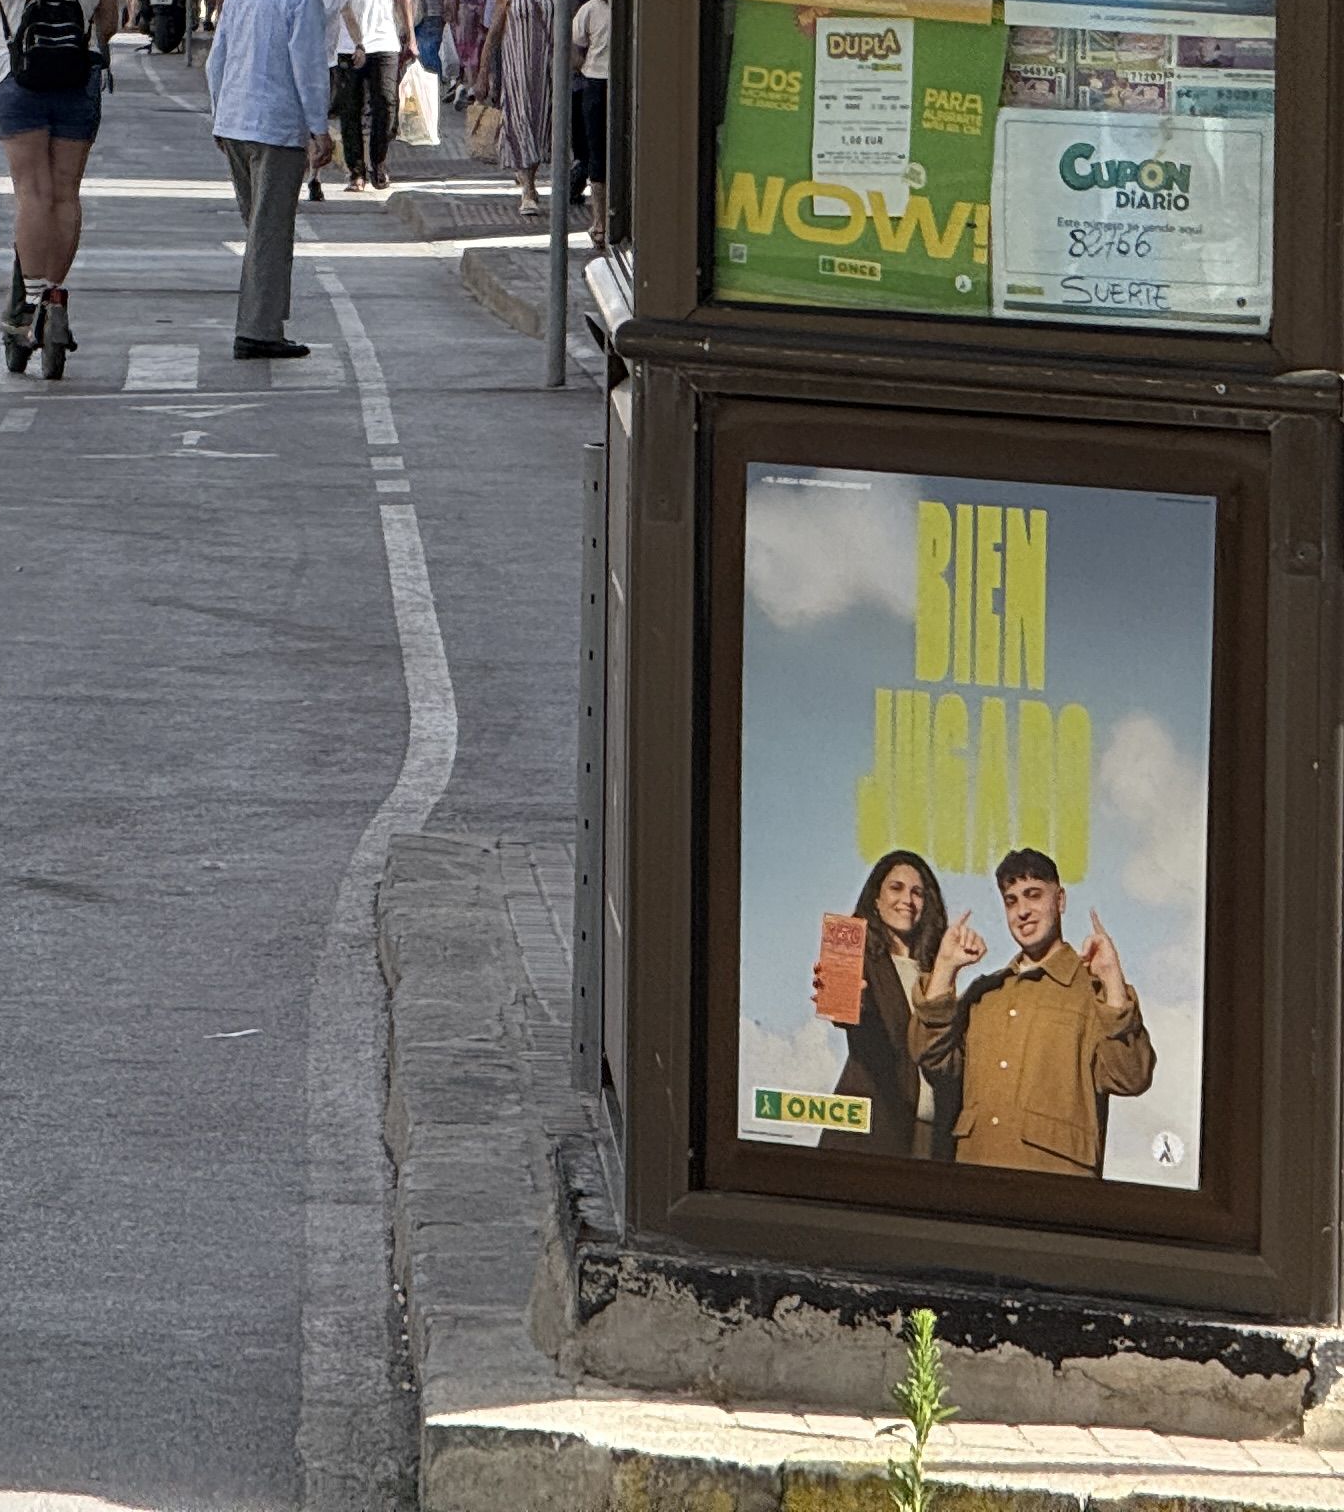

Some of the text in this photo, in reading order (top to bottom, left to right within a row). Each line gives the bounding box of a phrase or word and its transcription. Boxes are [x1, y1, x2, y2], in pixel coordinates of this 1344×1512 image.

[827, 28, 901, 61] DUPLA
[743, 65, 802, 93] DOS
[924, 88, 982, 115] PARA
[865, 135, 883, 145] EUR
[716, 169, 992, 264] WOW!
[1057, 216, 1080, 228] Este
[837, 261, 879, 277] ONCE
[1060, 275, 1172, 311] SUERTE
[914, 499, 1048, 691] BIEN
[855, 688, 1092, 884] JUGADO
[786, 1096, 863, 1125] ONCE
